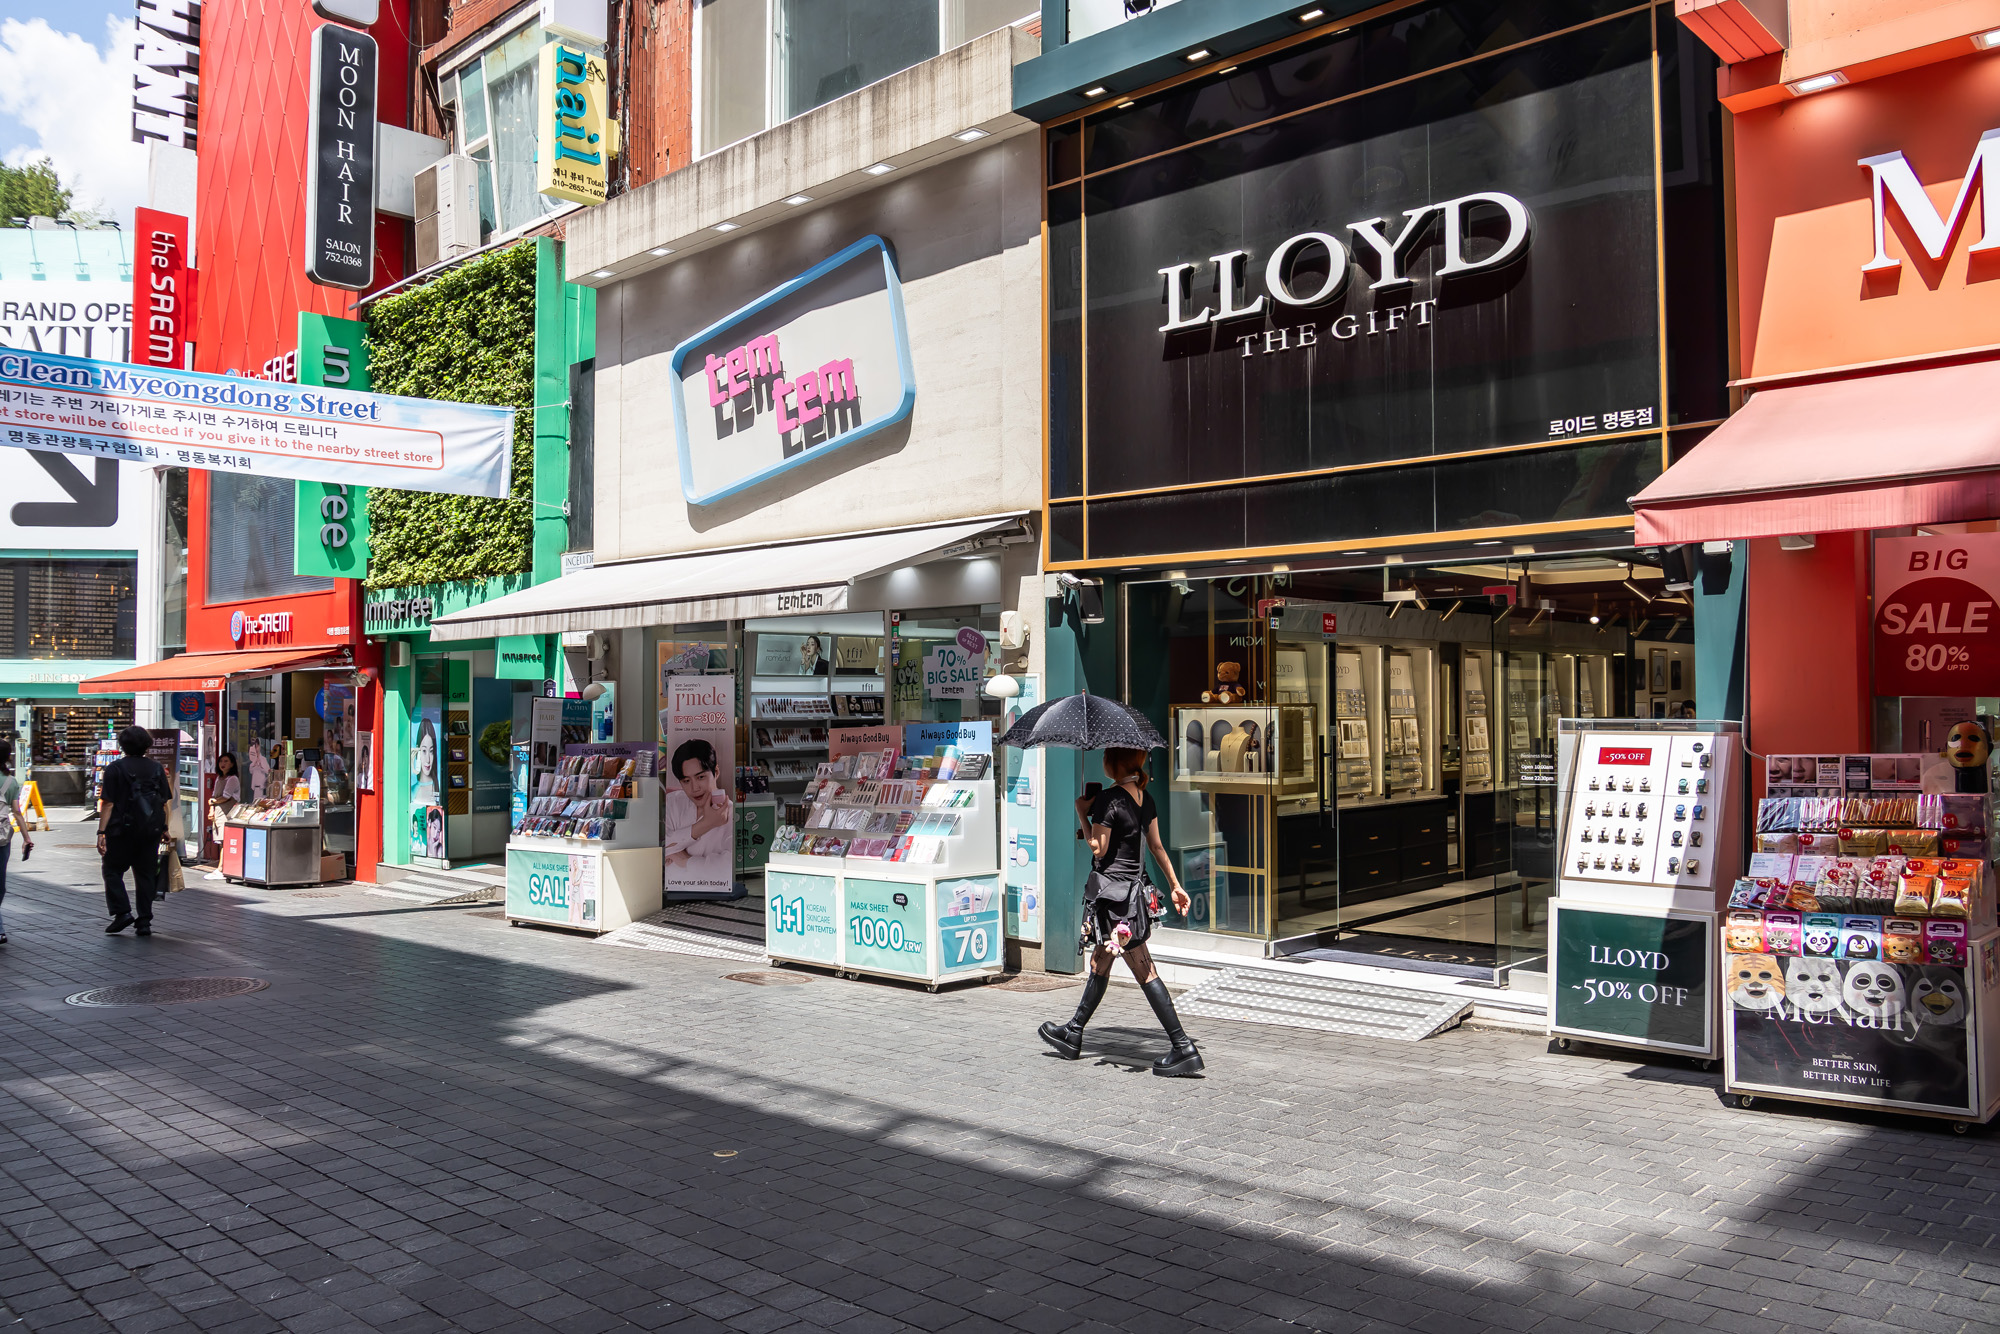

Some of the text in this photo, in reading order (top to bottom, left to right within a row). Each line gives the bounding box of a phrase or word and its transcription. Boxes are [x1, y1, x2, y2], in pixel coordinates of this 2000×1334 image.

[555, 45, 601, 166] nail
[337, 43, 361, 225] MOON HAIR
[553, 168, 604, 188] 제니 뷰티 Total
[552, 178, 605, 198] 010-2652-1400
[325, 238, 361, 255] SALON
[325, 251, 362, 268] 752-0368
[1157, 192, 1529, 333] LLOYD
[1236, 298, 1437, 359] THE GIFT
[705, 333, 782, 407] tem
[1, 356, 380, 420] Clean Myeongdong Street
[772, 357, 857, 434] tem
[51, 395, 83, 411] 주변
[90, 400, 168, 420] 거리가게로
[172, 408, 217, 427] 주시면
[222, 415, 278, 434] 수거하여
[283, 422, 338, 440] 드립니다
[1548, 406, 1653, 436] 로이드 명동점
[14, 407, 55, 423] store
[59, 413, 85, 426] will
[88, 415, 107, 428] be
[112, 418, 179, 437] collected
[184, 426, 194, 438] if
[198, 429, 223, 442] you
[228, 432, 256, 445] give
[260, 434, 270, 446] it
[275, 437, 288, 448] to
[292, 439, 313, 451] the
[317, 442, 360, 457] nearby
[364, 447, 400, 460] street
[403, 450, 433, 463] store
[8, 430, 251, 469] 명동관광특구협의회 명동복지회
[1908, 549, 1968, 572] BIG
[778, 592, 823, 611] temtem
[1881, 601, 1992, 635] SALE
[966, 632, 978, 643] BEST
[967, 639, 978, 650] BEST
[846, 647, 863, 659] tfit
[938, 649, 966, 668] 70%
[1905, 643, 1969, 671] 80%
[927, 666, 979, 685] BIG SALE
[862, 683, 873, 691] tfit
[941, 686, 964, 694] temtem
[840, 733, 889, 744] Always Good Buy
[920, 729, 976, 740] Always Good Buy
[1605, 752, 1645, 761] -50% OFF
[533, 862, 541, 870] ALL
[542, 863, 556, 872] MASK
[710, 879, 729, 887] today!
[771, 894, 804, 935] 1+1
[806, 904, 827, 913] KOREAN
[850, 901, 889, 913] MASK SHEET
[806, 914, 831, 924] SKINCARE
[963, 915, 977, 923] UP TO
[806, 924, 837, 935] ON TEMTEM
[850, 915, 922, 954] 1000 KRW
[1590, 944, 1670, 971] LLOYD
[1571, 978, 1689, 1006] ~50% OFF
[1812, 1058, 1881, 1074] BETTER SKIN,
[1803, 1070, 1891, 1088] BETTER NEW LIFE
